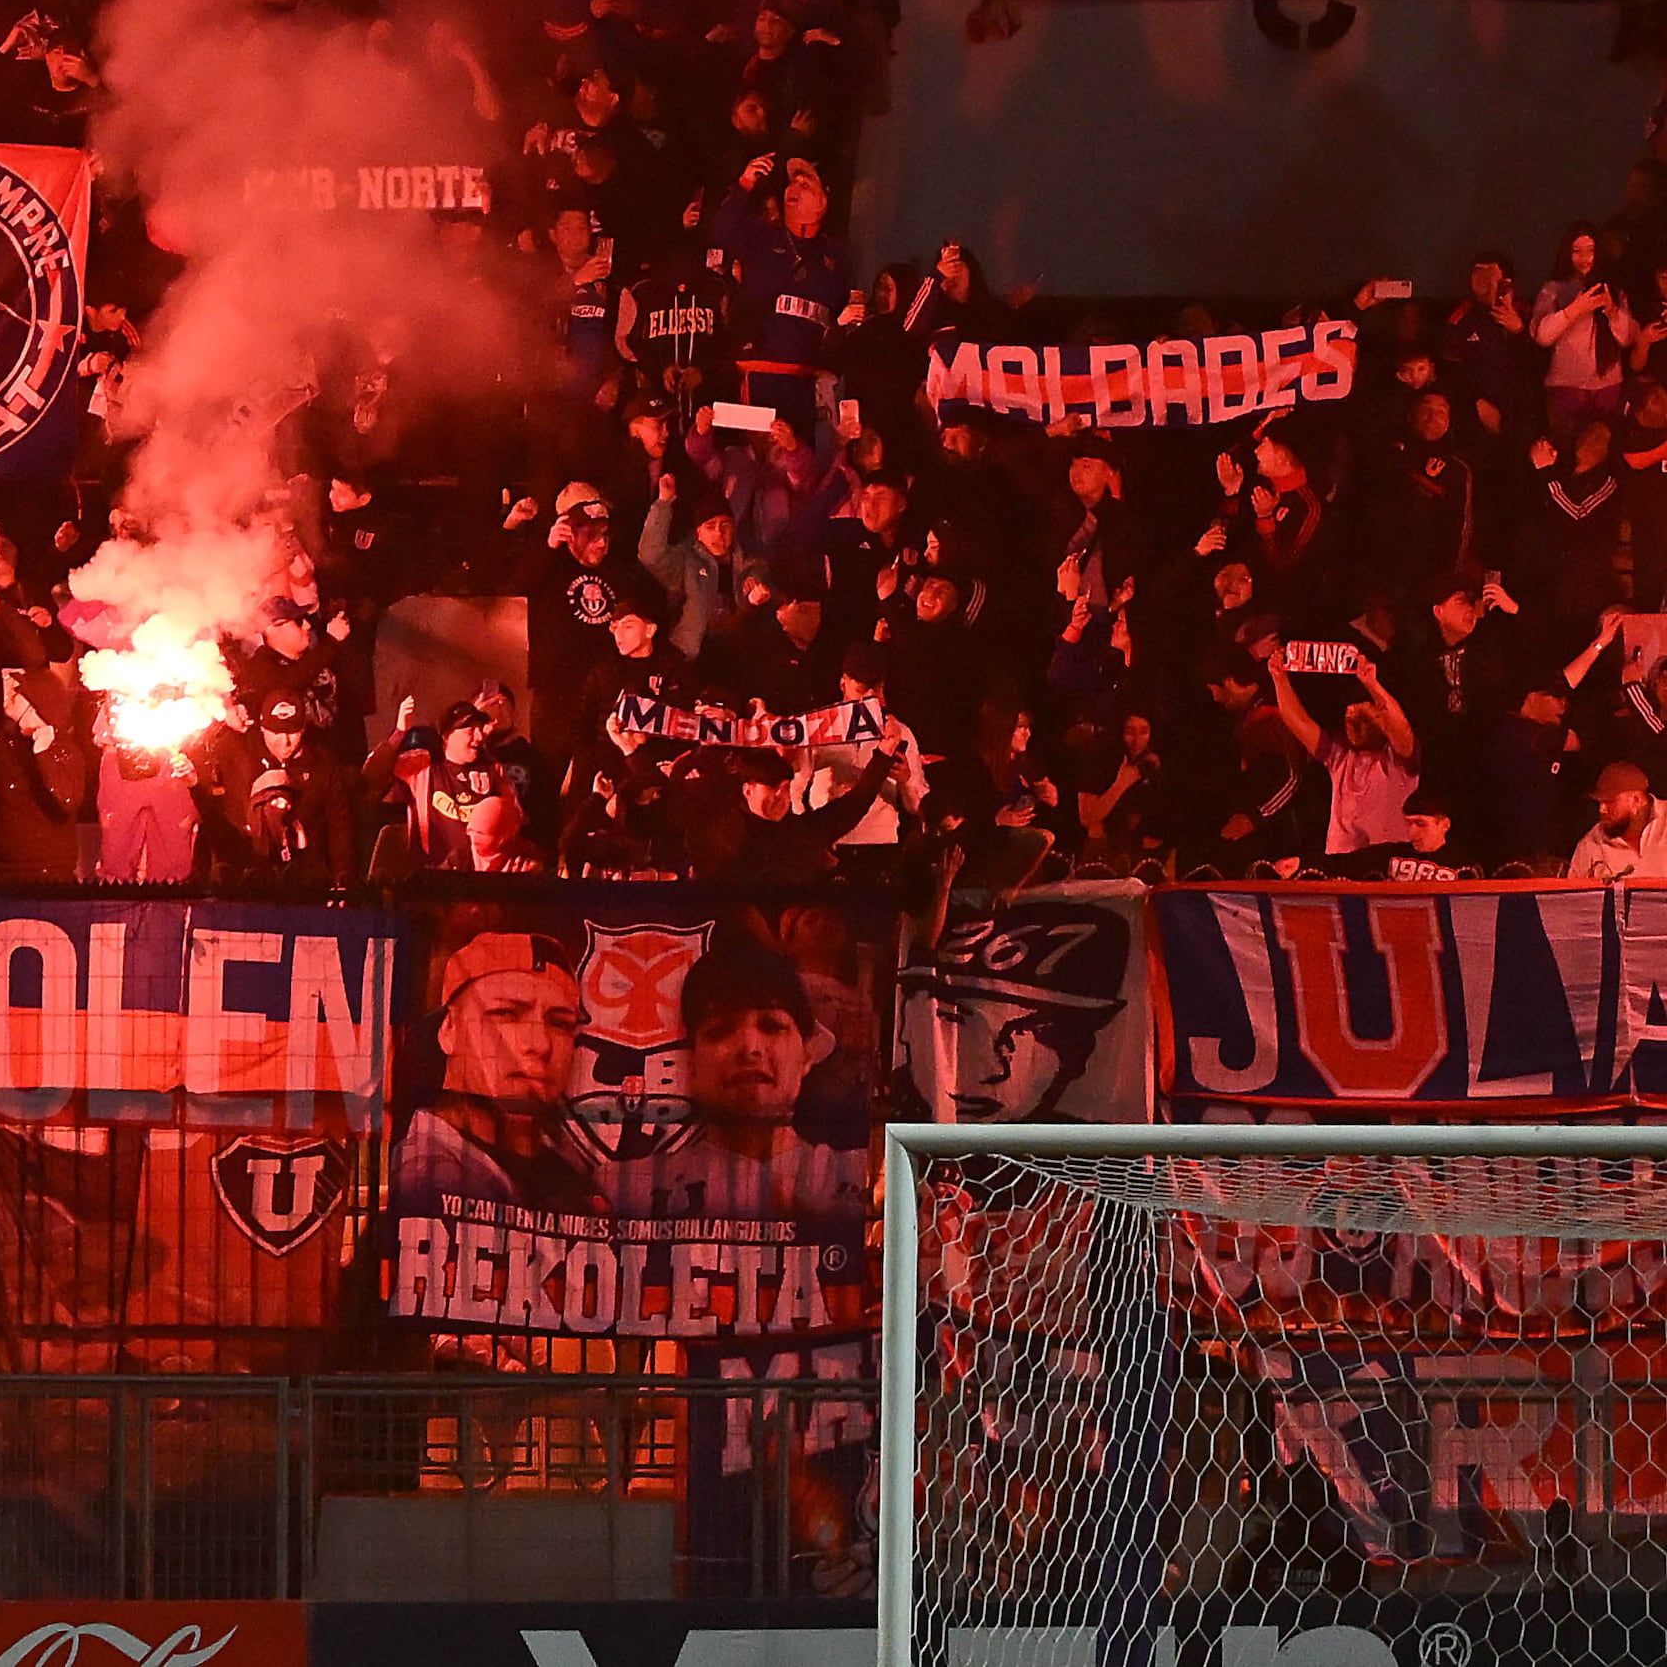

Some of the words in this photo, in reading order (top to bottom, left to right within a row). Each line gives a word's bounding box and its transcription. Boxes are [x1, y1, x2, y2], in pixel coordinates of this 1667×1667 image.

[358, 165, 485, 210] NORTE
[648, 308, 714, 340] ELLESSE
[927, 318, 1360, 430] MALDADES
[441, 1193, 462, 1217] YO
[516, 1205, 534, 1230] EN
[537, 1208, 555, 1233] LA
[617, 1218, 673, 1241] SOMOS
[674, 1218, 796, 1243] BULLANGUEROS
